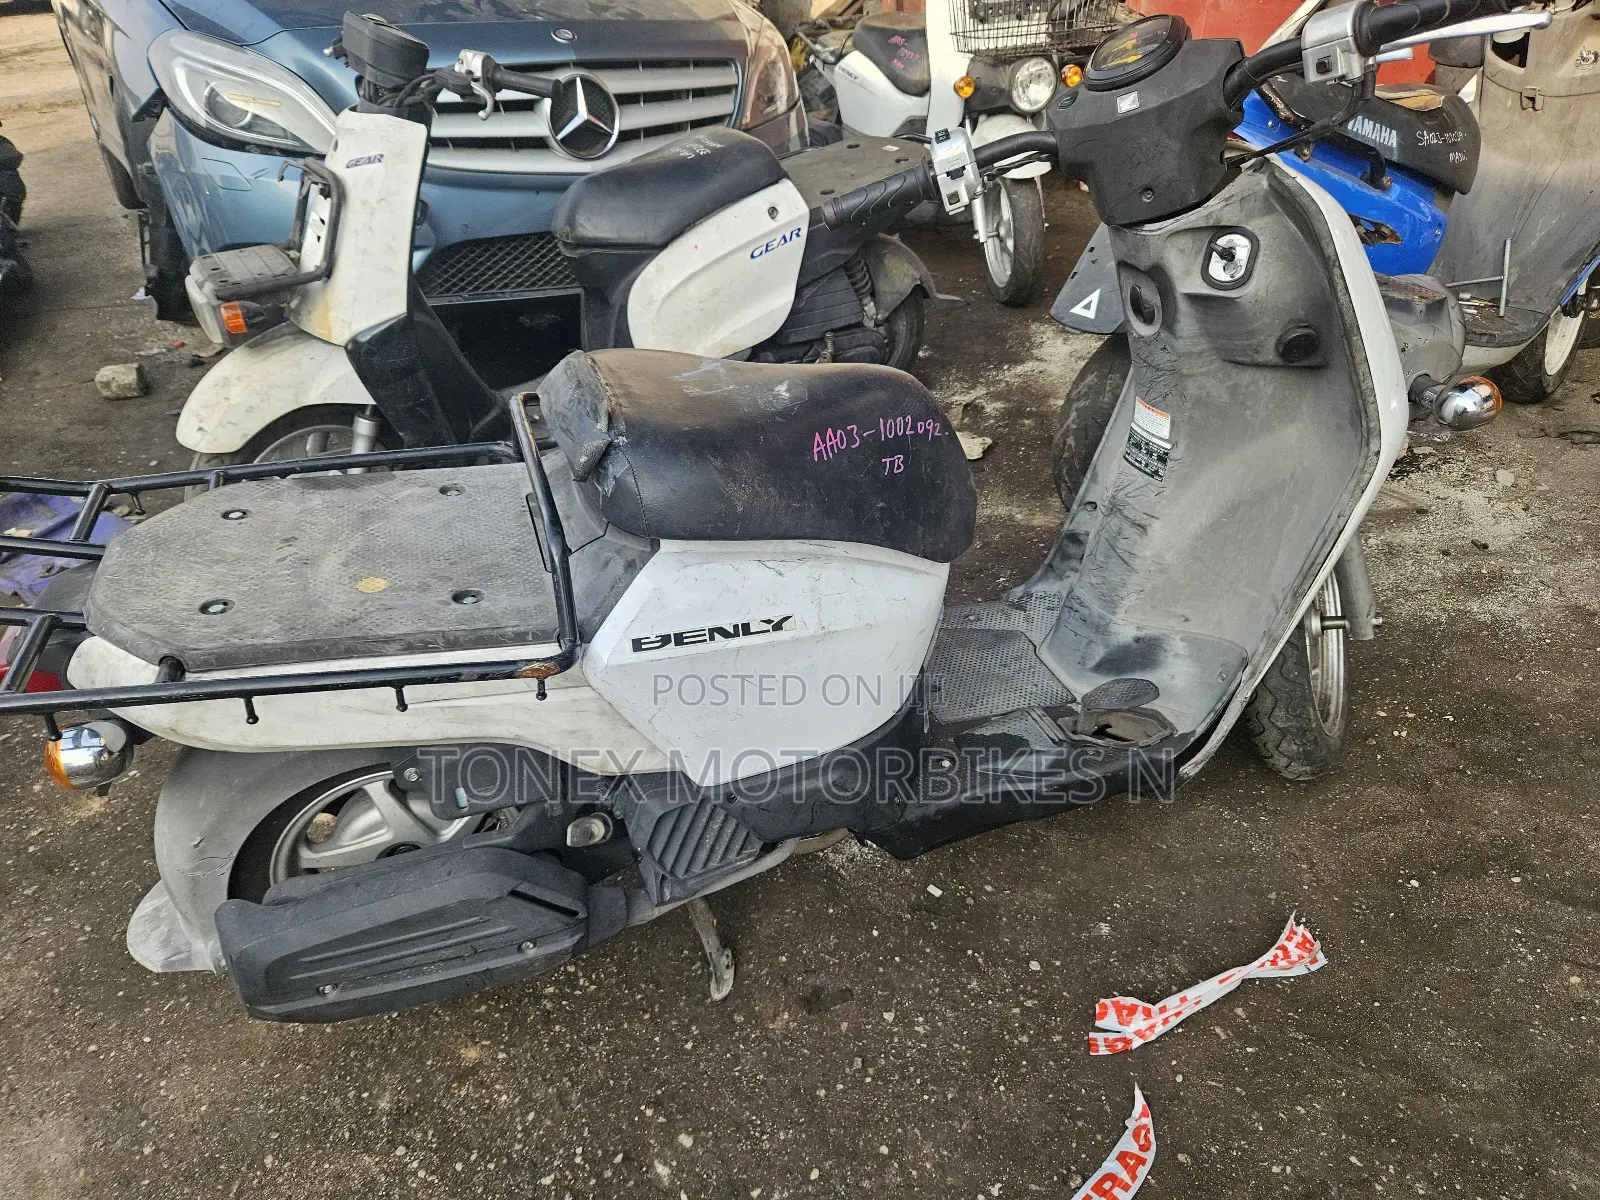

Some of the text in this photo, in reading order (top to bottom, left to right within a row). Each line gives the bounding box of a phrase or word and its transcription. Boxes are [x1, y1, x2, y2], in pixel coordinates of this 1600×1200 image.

[345, 153, 385, 169] GEAR
[750, 227, 802, 260] GEAR
[881, 454, 905, 476] TB
[631, 614, 794, 653] BENLY
